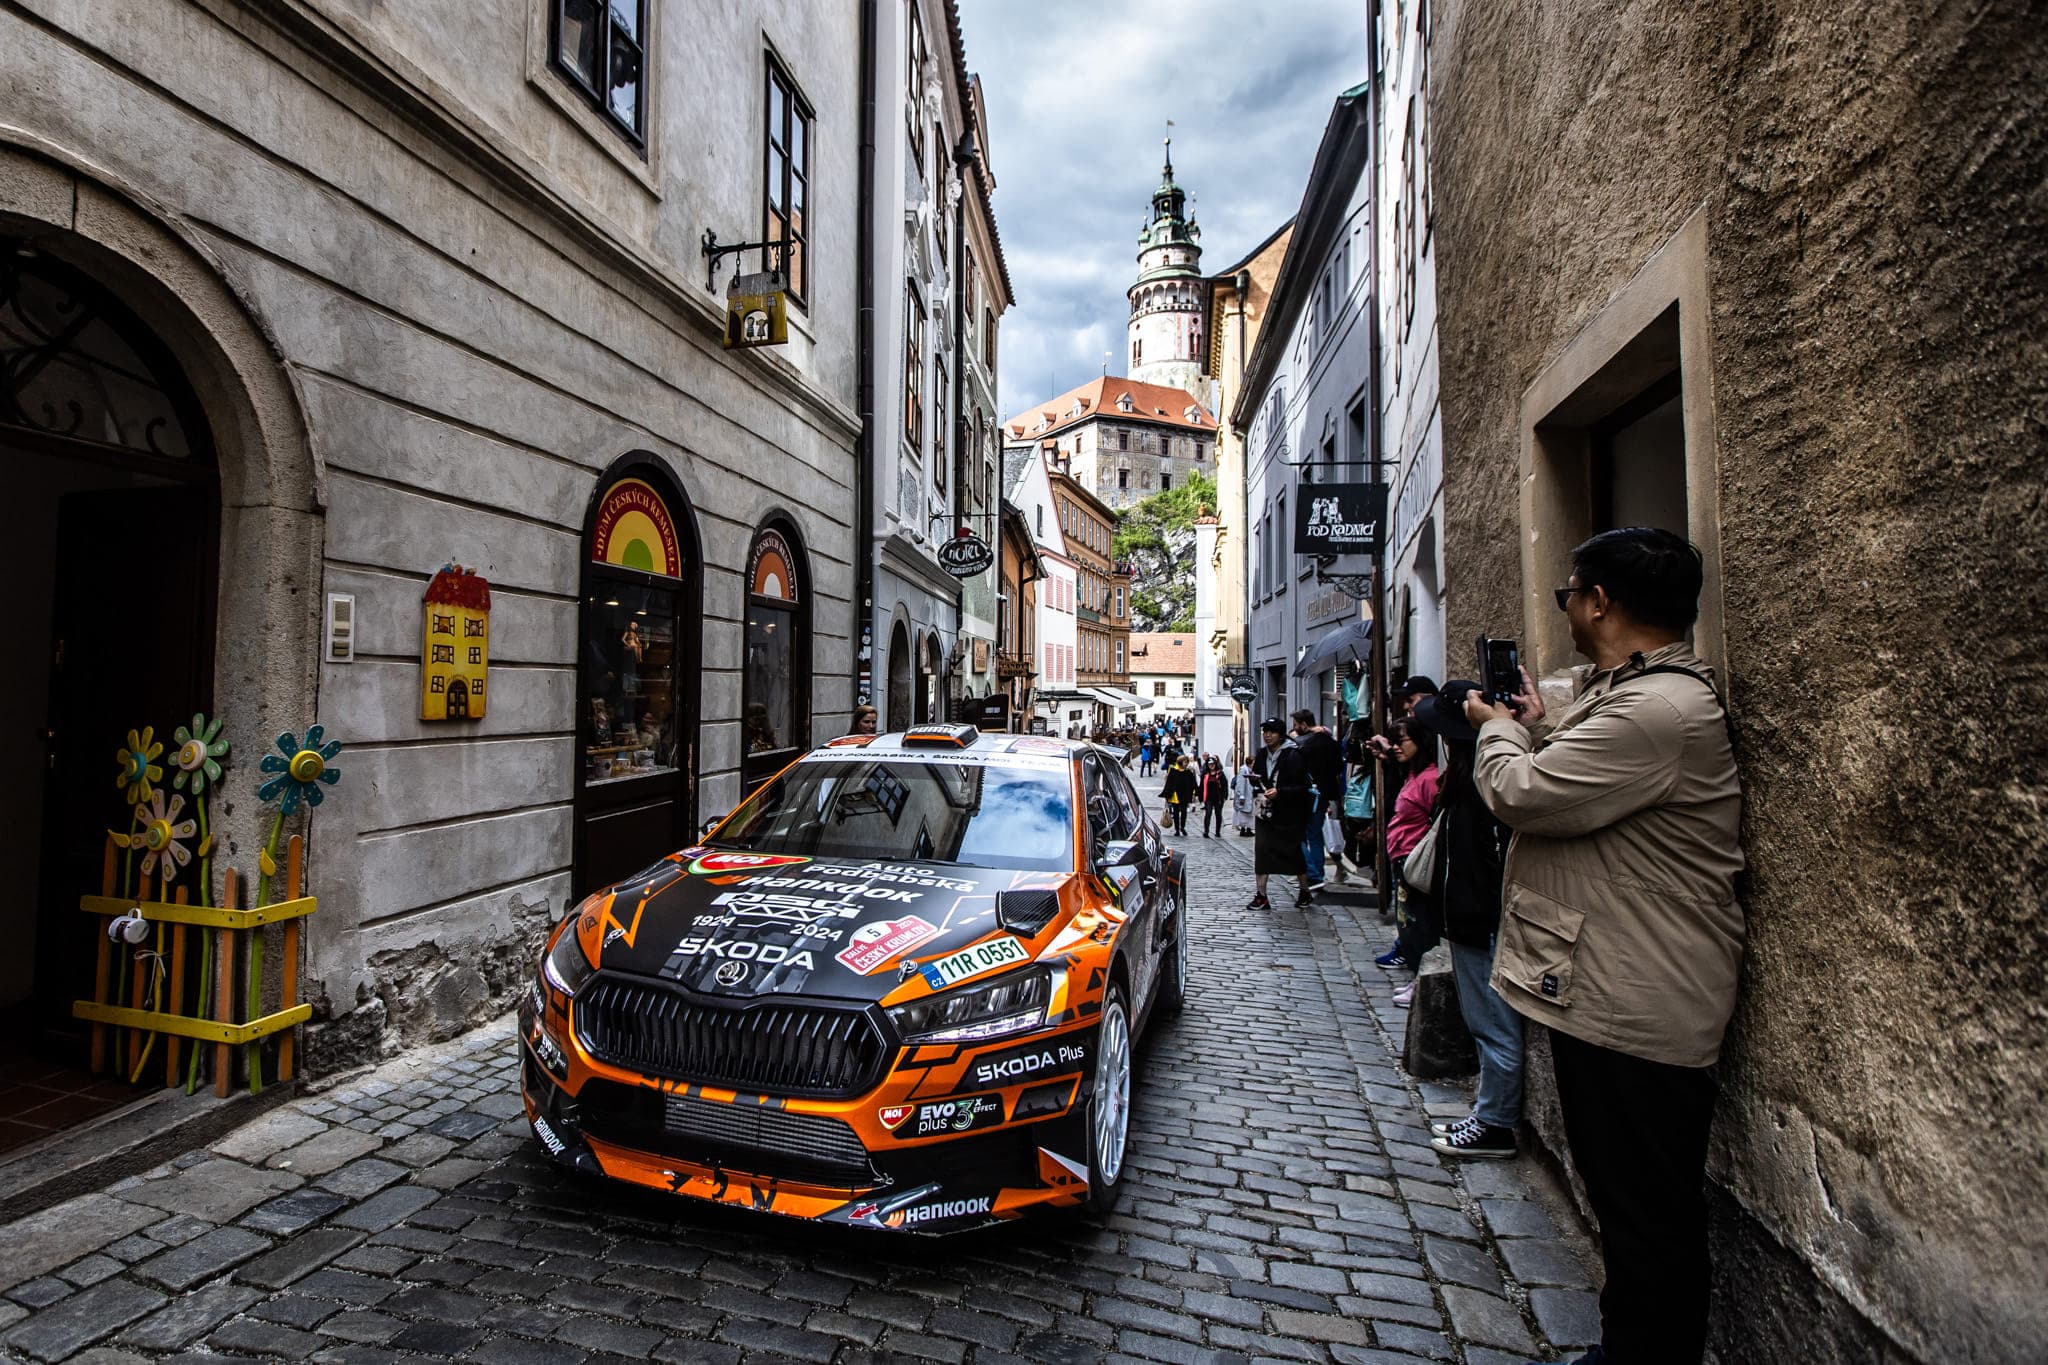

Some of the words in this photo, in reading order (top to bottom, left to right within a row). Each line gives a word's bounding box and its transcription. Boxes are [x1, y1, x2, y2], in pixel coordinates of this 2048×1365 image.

[609, 488, 649, 513] ČESKÝCH
[1306, 525, 1329, 537] POD
[706, 855, 772, 864] MOL
[861, 863, 935, 876] Auto
[691, 915, 737, 927] 1924
[790, 924, 844, 941] 2024
[867, 928, 881, 937] 5
[854, 943, 889, 968] ČESKÝ
[884, 925, 928, 950] KRUMLOV
[941, 954, 978, 978] 11R
[977, 940, 1025, 965] 0551
[931, 977, 944, 988] CZ
[1059, 1045, 1085, 1063] Plus
[883, 1109, 902, 1119] MOL
[920, 1103, 956, 1120] EVO
[973, 1104, 998, 1113] EFFECT
[918, 1118, 947, 1134] plus
